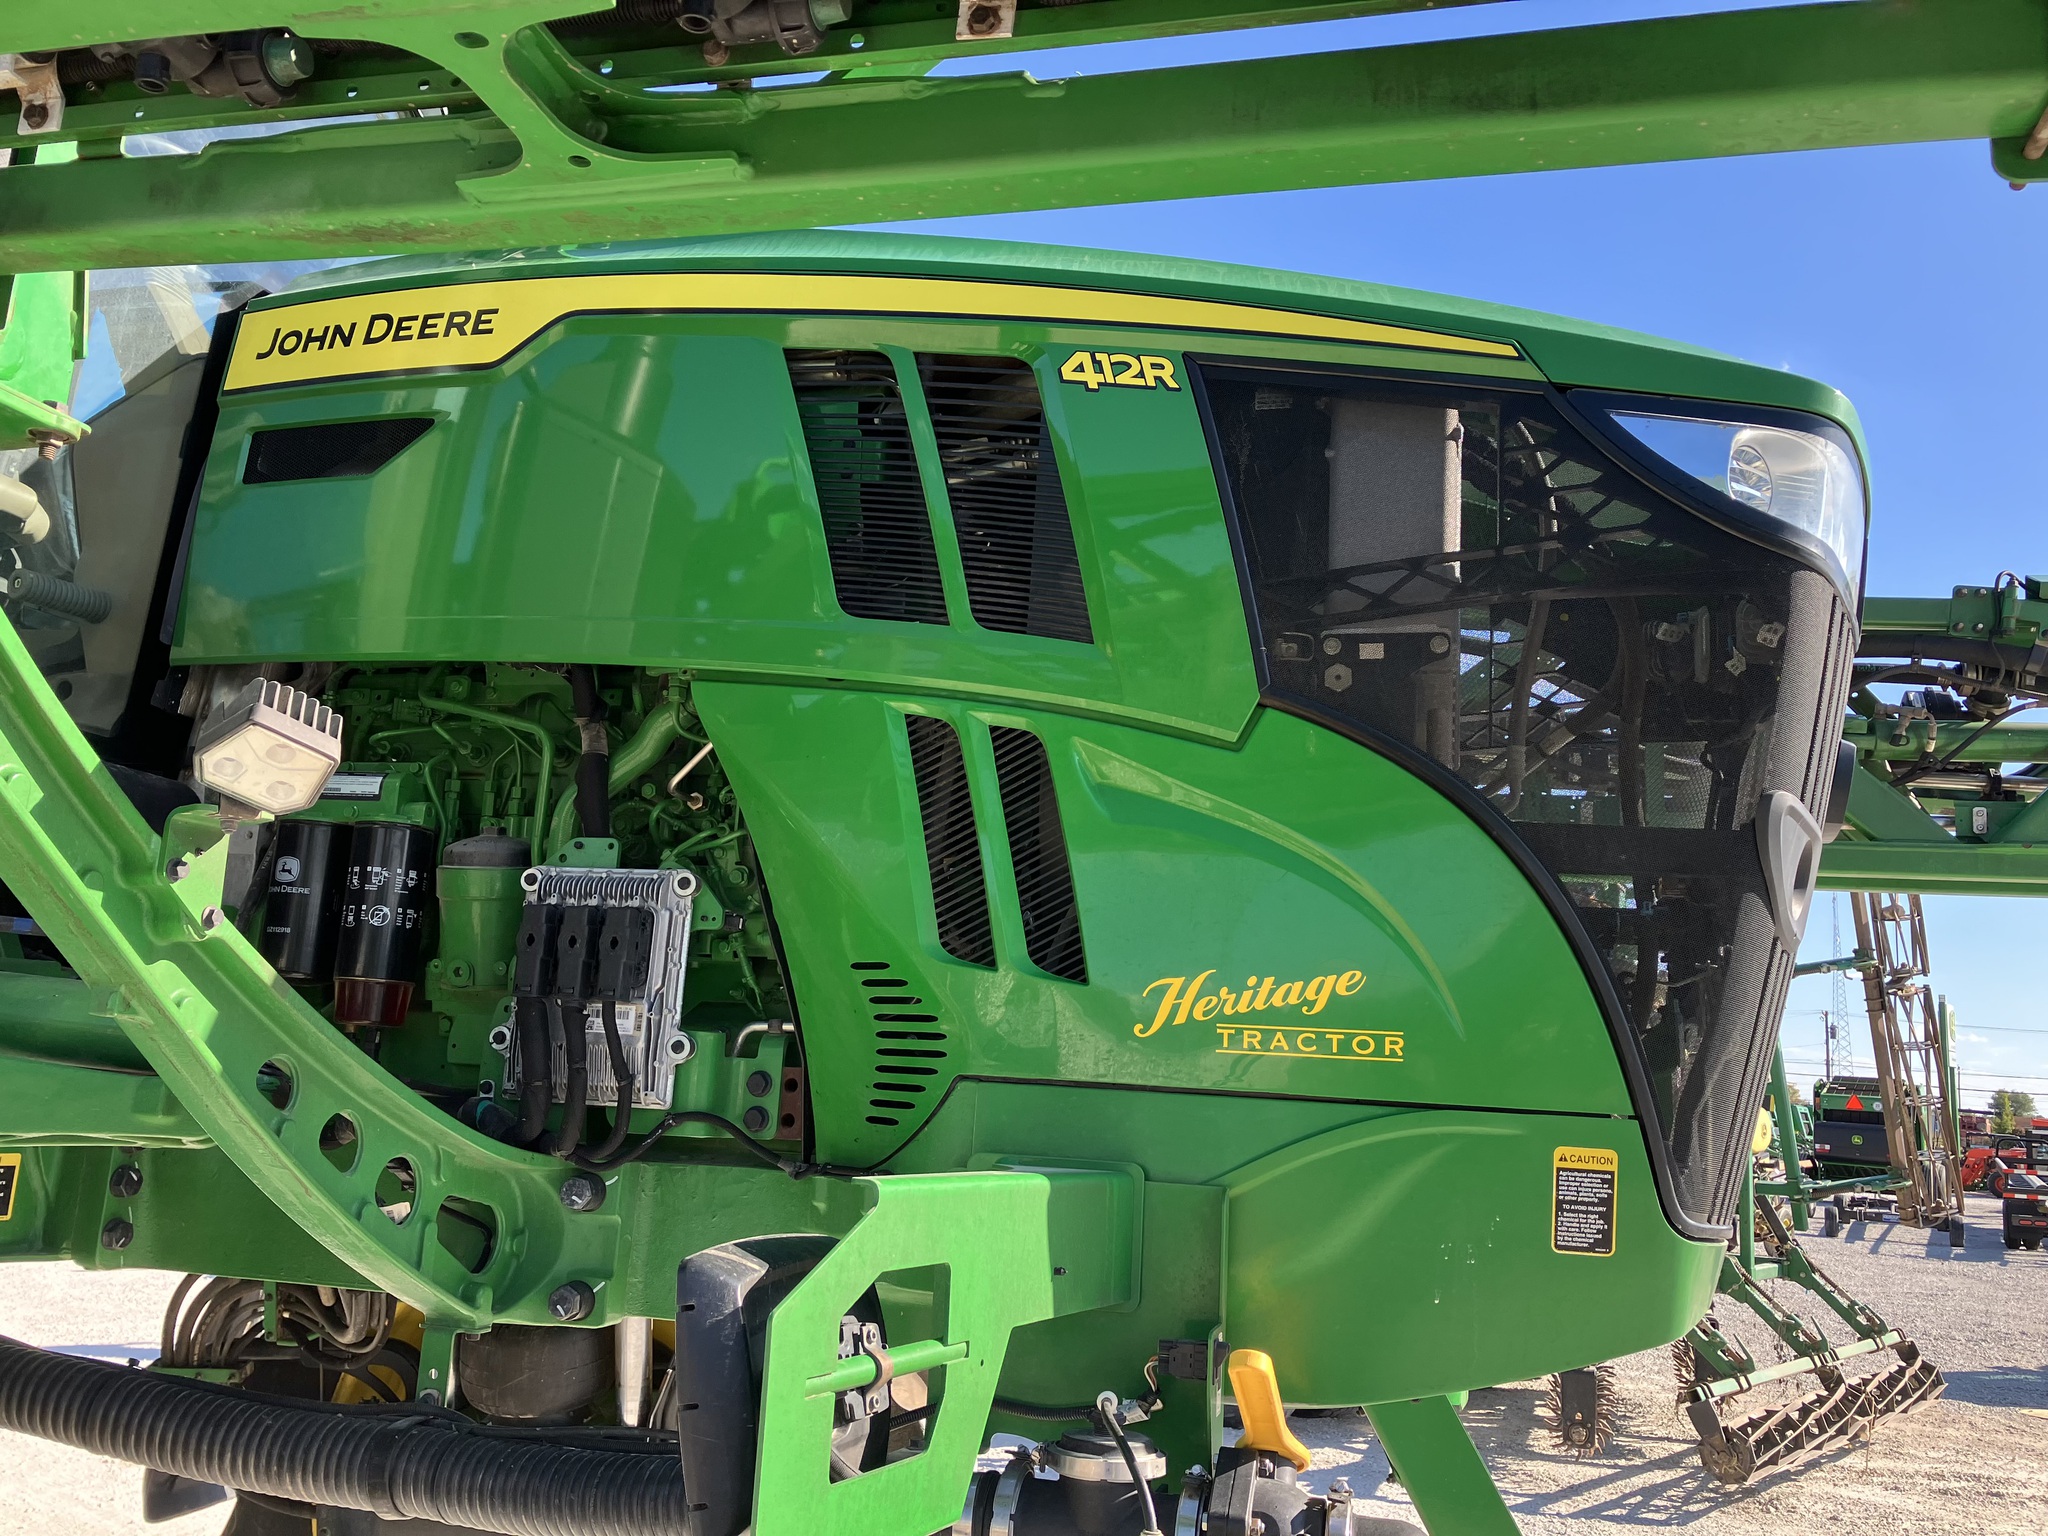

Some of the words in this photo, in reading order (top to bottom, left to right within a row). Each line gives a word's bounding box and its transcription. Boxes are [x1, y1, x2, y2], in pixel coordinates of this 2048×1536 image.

[256, 322, 356, 360] JOHN
[362, 308, 499, 346] DEERE
[1059, 350, 1181, 391] 412R
[281, 885, 311, 894] DEERE
[1133, 969, 1366, 1038] Heritage
[1216, 1028, 1404, 1056] TRACTOR
[1569, 1154, 1614, 1165] CAUTION
